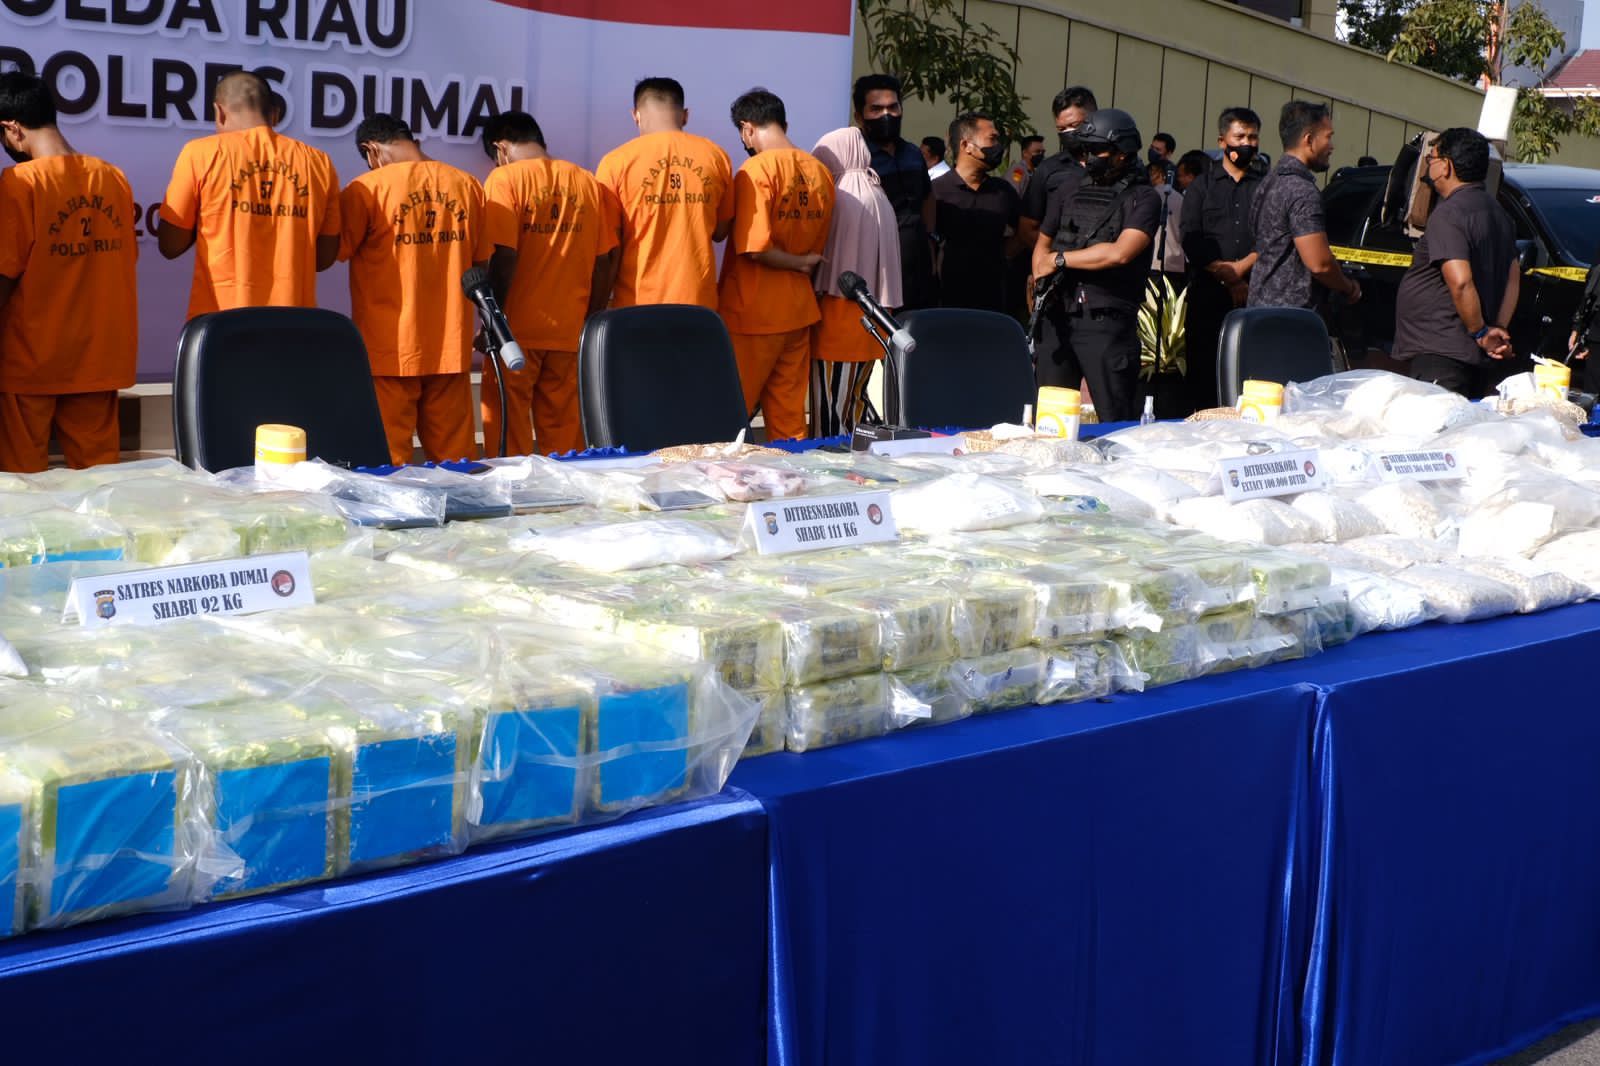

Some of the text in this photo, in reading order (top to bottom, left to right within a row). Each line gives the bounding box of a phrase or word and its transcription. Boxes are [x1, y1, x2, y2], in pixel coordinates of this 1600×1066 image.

[245, 0, 407, 49] RIAU
[670, 173, 682, 189] 58
[644, 192, 711, 206] POLDA RIAU
[231, 200, 309, 219] POLDA RIAU
[425, 210, 437, 228] 27
[81, 215, 92, 237] 2
[395, 229, 466, 246] POLDA RIAU
[1243, 459, 1298, 478] DITRESNARKOBA
[783, 501, 860, 523] DITRESNARKOBA
[795, 522, 859, 543] SHABU 111 KG
[116, 567, 269, 601] SATRES NARKOBA DUMAI
[152, 593, 244, 620] SHABU 92 KG
